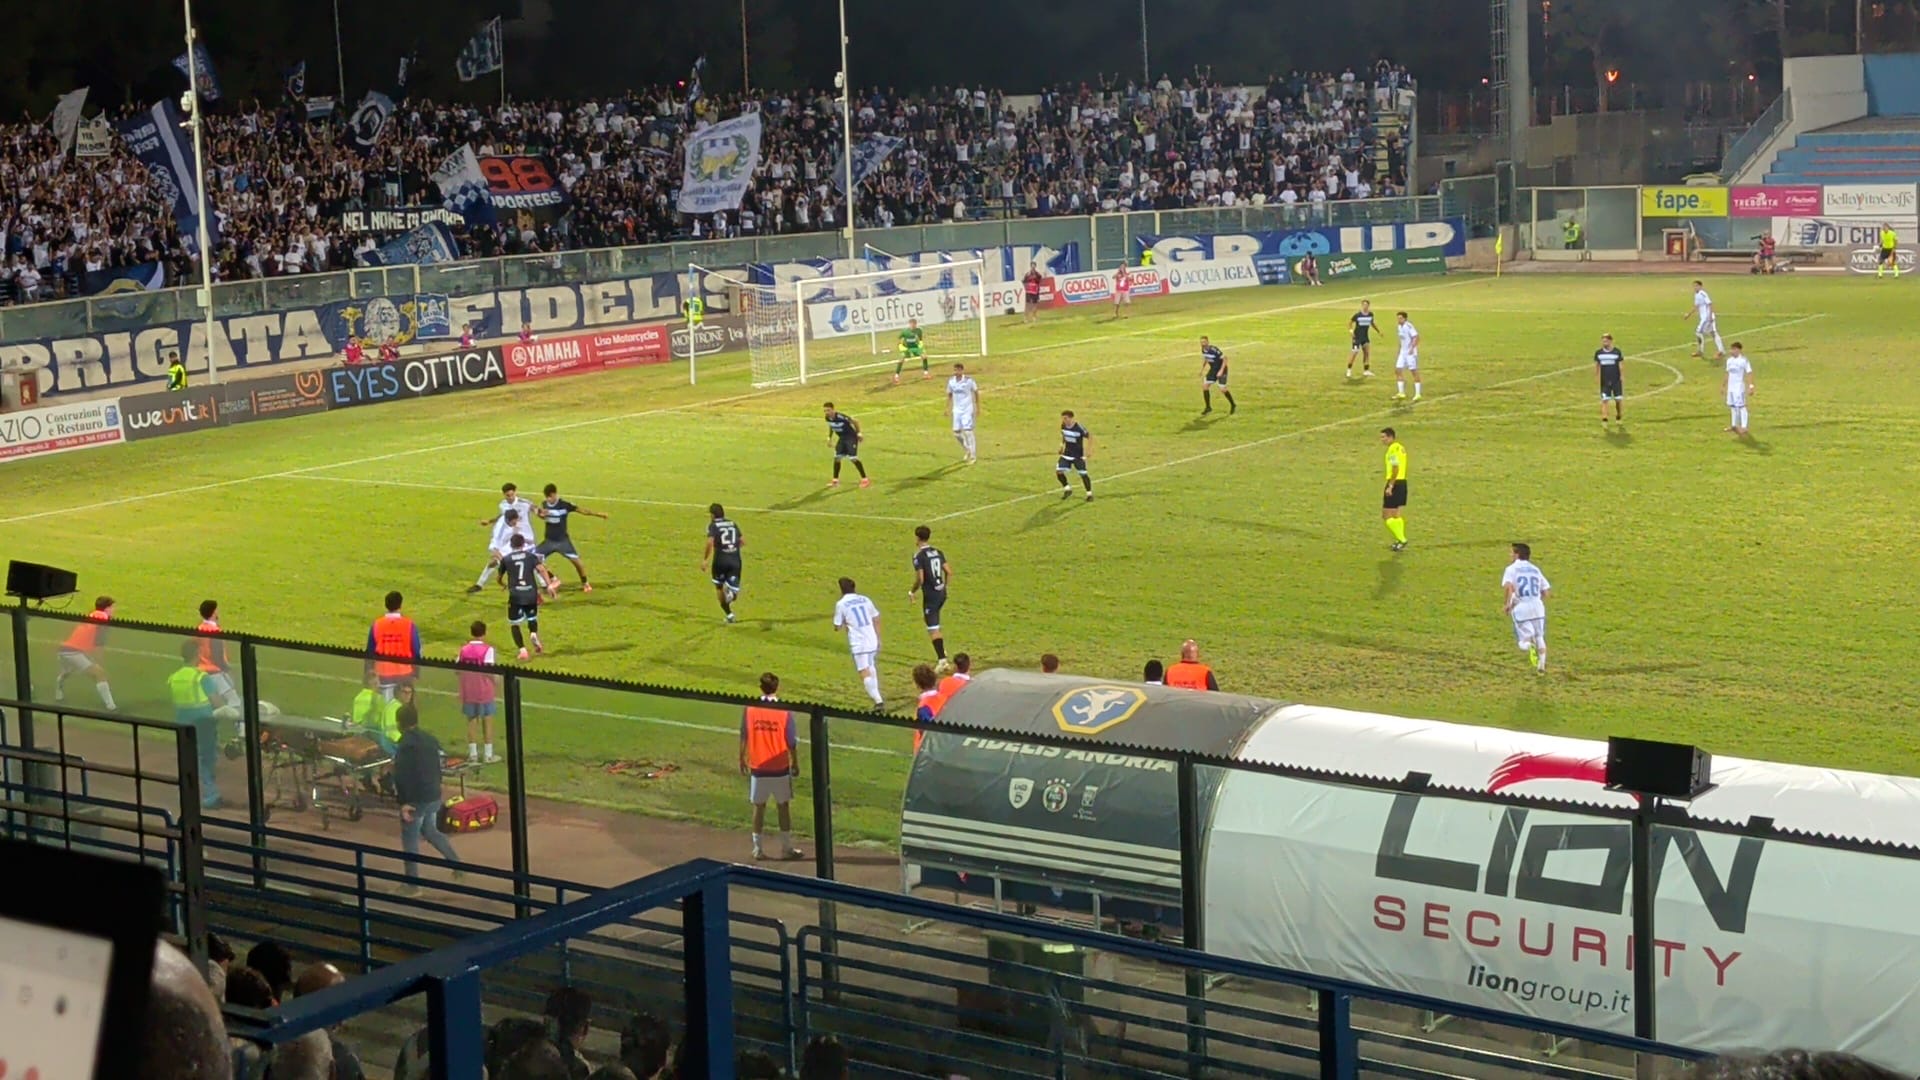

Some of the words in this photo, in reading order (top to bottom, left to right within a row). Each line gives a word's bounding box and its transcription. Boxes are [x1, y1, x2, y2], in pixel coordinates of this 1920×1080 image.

[480, 157, 555, 193] 98
[1656, 190, 1699, 212] fape
[1825, 227, 1843, 244] DI
[1065, 277, 1106, 294] GOLOSIA
[1184, 269, 1220, 285] ACQUA
[1223, 265, 1254, 281] IGEA
[850, 308, 869, 325] et
[876, 297, 924, 321] office
[0, 309, 333, 394] BRIGATA
[526, 340, 582, 365] YAMAHA
[331, 364, 399, 403] EYES
[404, 350, 503, 392] OTTICA
[46, 406, 102, 424] Costruzioni
[57, 420, 103, 435] Restauro
[720, 527, 736, 545] 27
[515, 561, 525, 580] 7
[1517, 576, 1539, 597] 26
[851, 605, 870, 627] 11
[1375, 793, 1765, 934] LION
[1373, 895, 1741, 986] SECURITY
[1467, 965, 1633, 1014] liongroup.it
